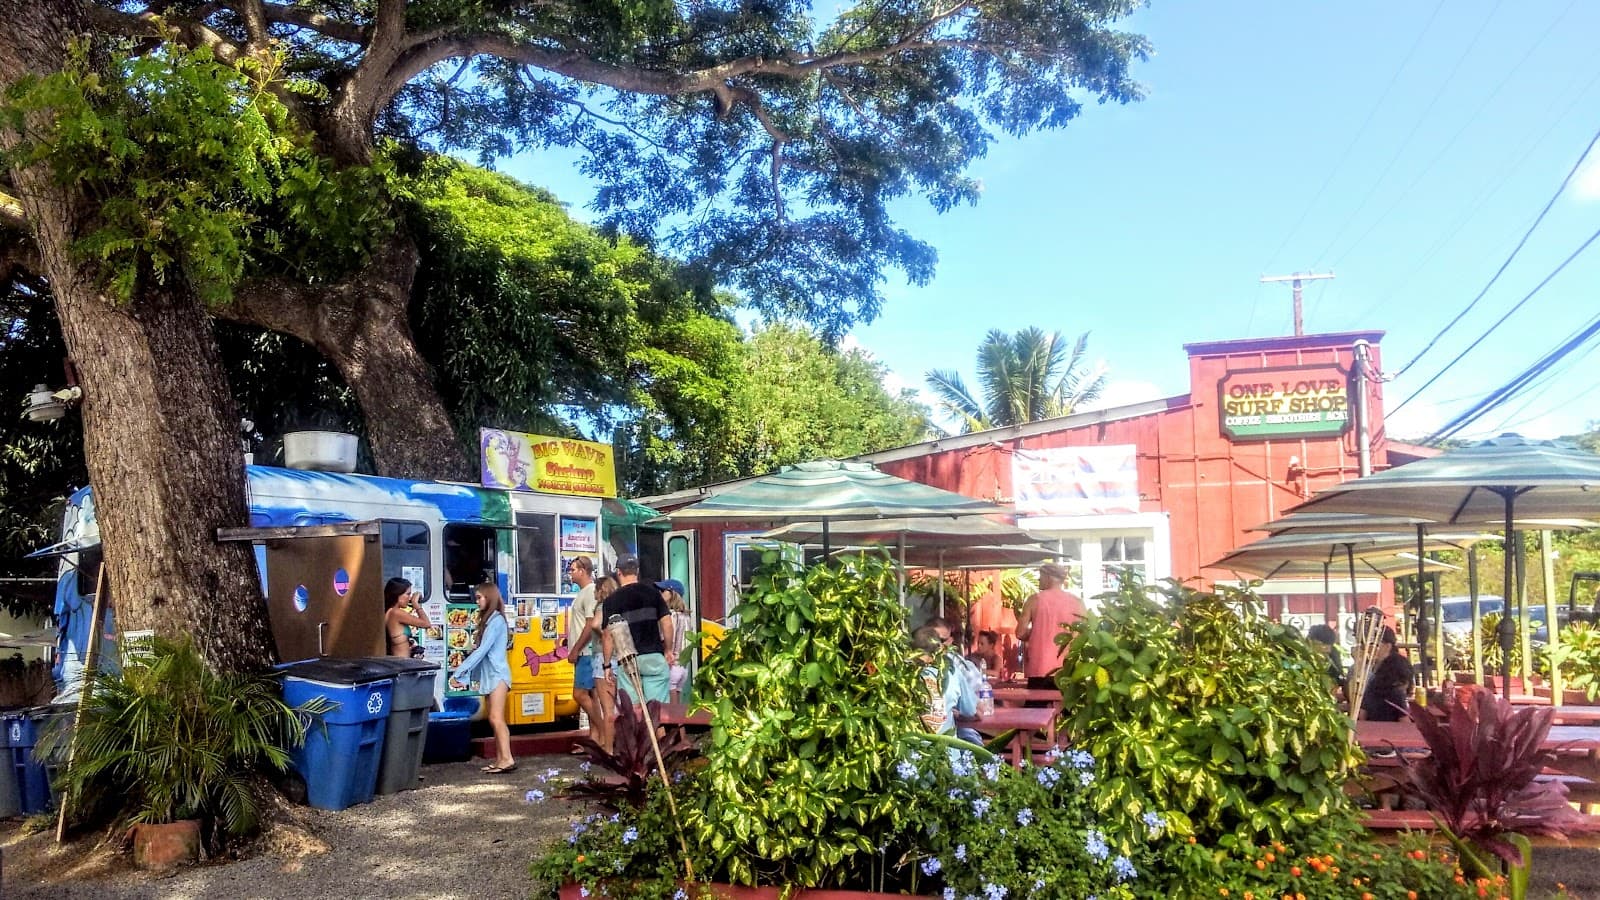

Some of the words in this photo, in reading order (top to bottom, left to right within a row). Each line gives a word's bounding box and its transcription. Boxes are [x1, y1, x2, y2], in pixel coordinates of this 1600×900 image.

[1230, 383, 1274, 400] ONE
[1281, 379, 1341, 397] LOVE
[1226, 399, 1284, 416] SURF
[1289, 395, 1347, 413] SHOP
[531, 441, 559, 459] BIG
[561, 440, 606, 467] WAVE
[546, 461, 595, 482] Shrimp
